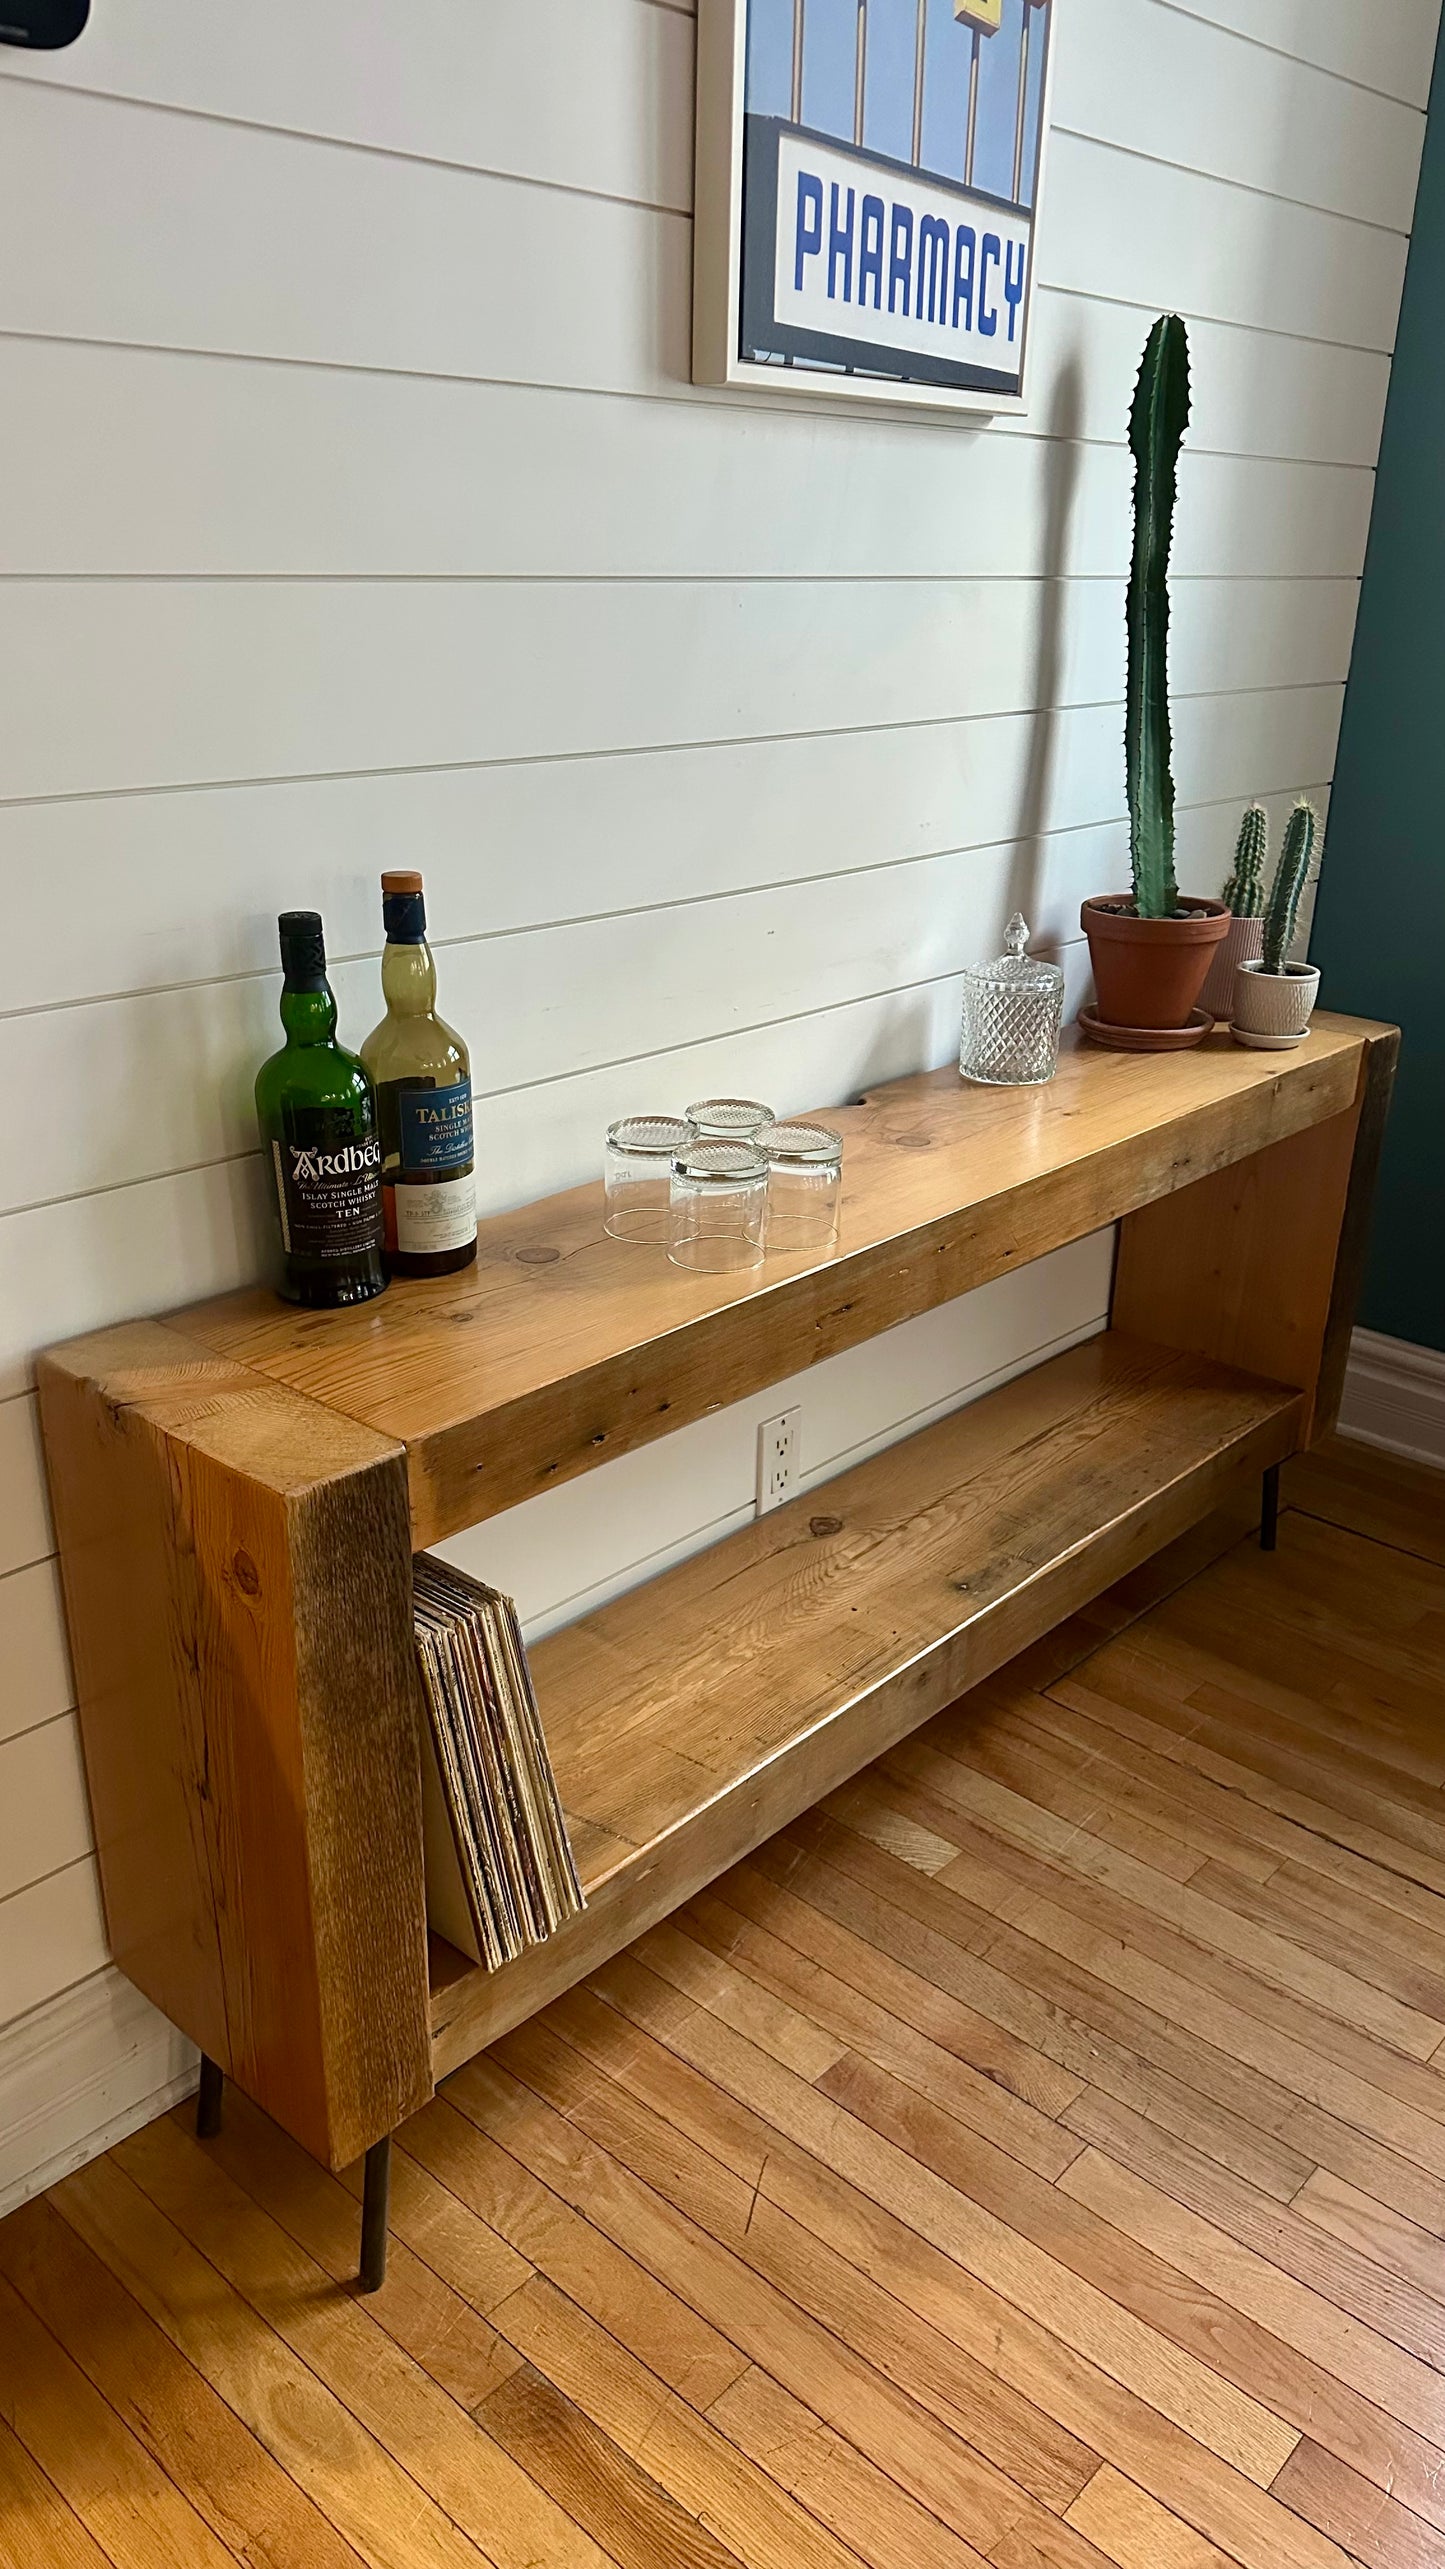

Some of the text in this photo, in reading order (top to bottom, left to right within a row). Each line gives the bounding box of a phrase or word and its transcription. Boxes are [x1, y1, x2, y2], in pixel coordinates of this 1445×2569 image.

[794, 170, 1026, 342] PHARMACY
[435, 1121, 461, 1132] SINGLE
[429, 1130, 459, 1141] SCOTCH
[331, 1188, 362, 1199] SINGLE
[363, 1179, 379, 1192] MALT
[310, 1200, 346, 1209] SCOTCH
[348, 1191, 376, 1206] WHISKY
[335, 1207, 360, 1218] TEN
